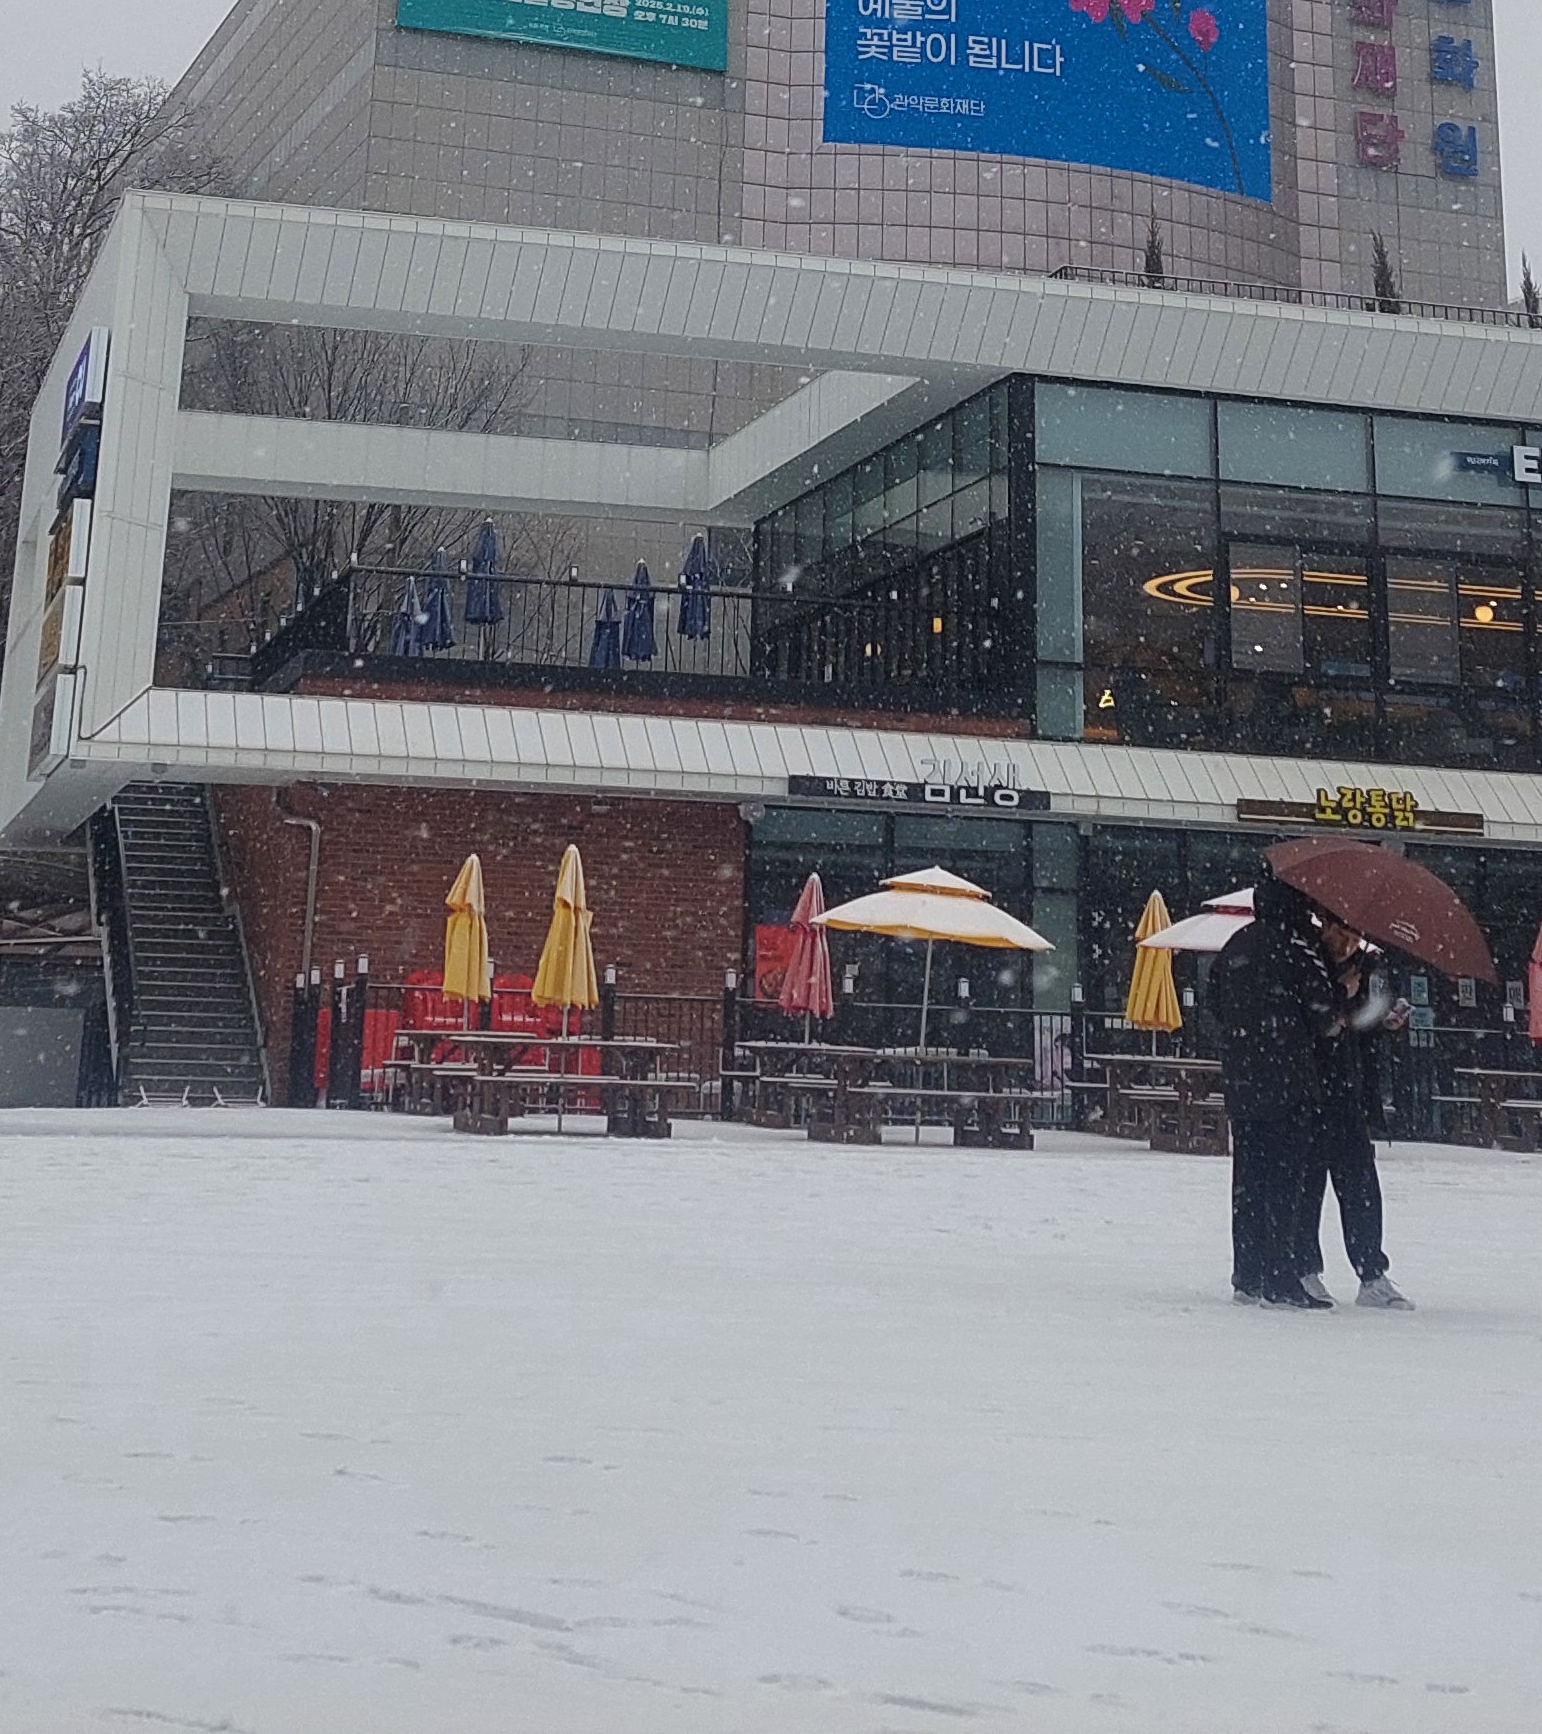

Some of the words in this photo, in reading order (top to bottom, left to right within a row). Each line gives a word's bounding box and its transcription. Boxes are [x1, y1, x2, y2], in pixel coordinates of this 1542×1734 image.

[633, 10, 657, 22] 오후
[658, 14, 679, 26] 7시
[681, 17, 709, 31] 30분
[856, 28, 957, 66] 꽃밭이
[966, 36, 1064, 77] 됩니다
[892, 94, 986, 117] 관악문화재단
[826, 778, 851, 797] 바른
[854, 781, 880, 798] 김밥
[920, 758, 1021, 807] 김선생
[1315, 786, 1418, 828] 노랑통닭
